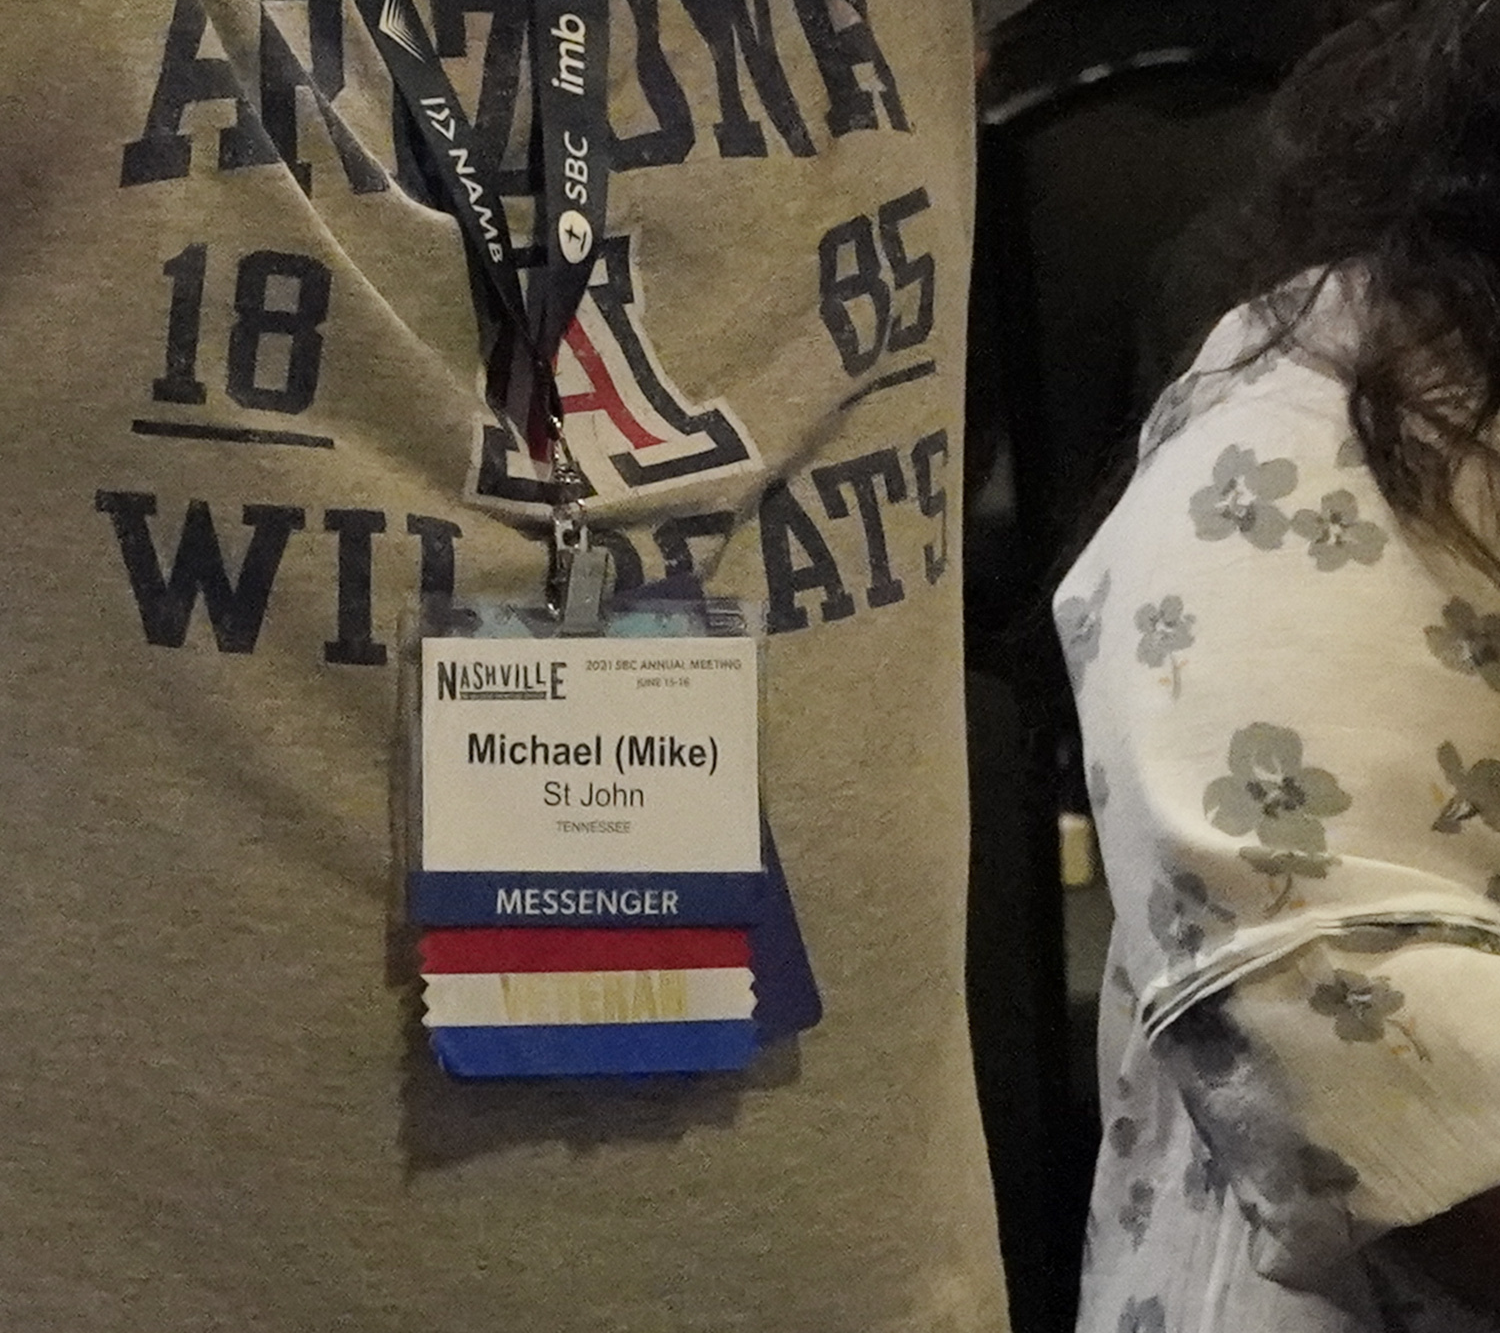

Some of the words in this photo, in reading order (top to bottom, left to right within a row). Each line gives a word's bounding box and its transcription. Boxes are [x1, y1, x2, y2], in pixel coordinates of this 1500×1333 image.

[551, 13, 585, 95] imb
[564, 130, 588, 204] SBC
[449, 149, 503, 263] NAMB
[820, 187, 937, 378] 85
[152, 243, 332, 414] 18
[437, 661, 567, 701] NASHVILLE
[585, 660, 612, 671] 2021
[614, 660, 637, 671] SBC
[640, 660, 685, 671] ANNUAL
[690, 659, 742, 671] MEETING
[467, 733, 601, 766] Michael
[615, 736, 719, 775] (Mike)
[543, 782, 571, 807] St
[580, 783, 645, 807] John
[556, 821, 631, 833] TENNESSEE
[495, 889, 679, 915] MESSENGER
